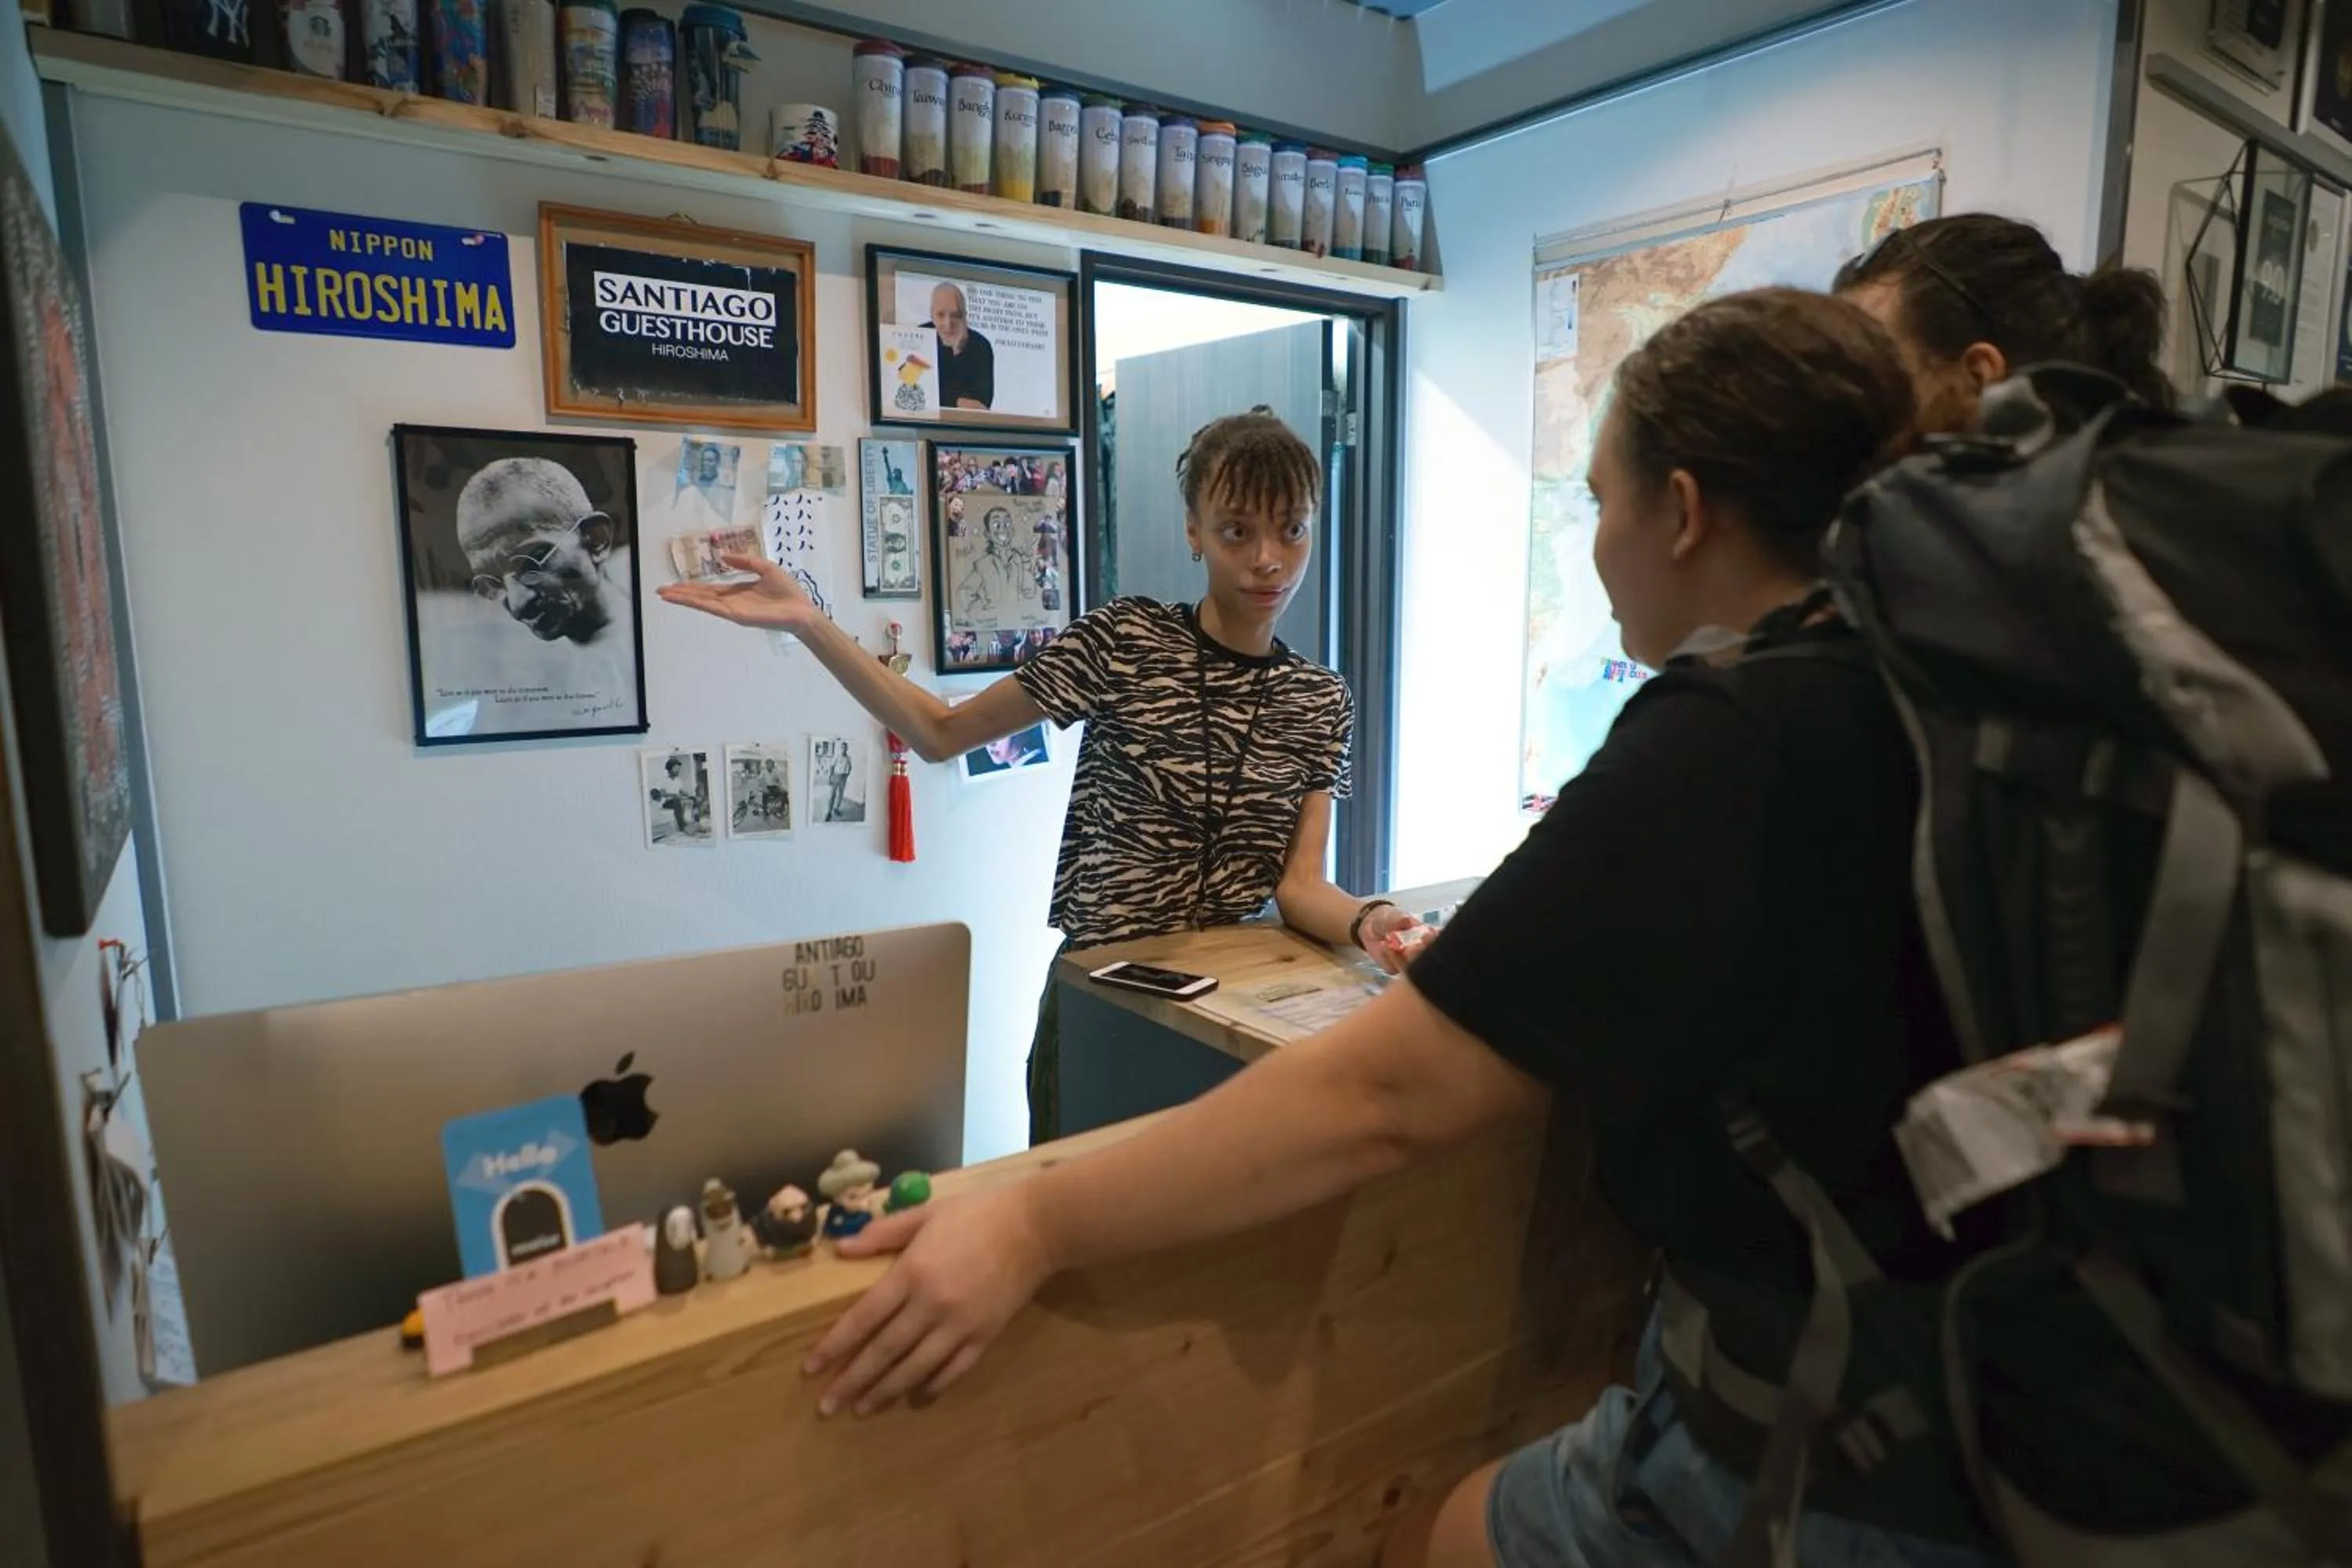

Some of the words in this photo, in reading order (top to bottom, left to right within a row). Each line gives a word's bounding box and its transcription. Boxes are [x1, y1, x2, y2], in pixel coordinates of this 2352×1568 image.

[329, 229, 434, 261] NIPPON
[255, 261, 507, 332] HIROSHIMA
[598, 278, 773, 321] SANTIAGO
[600, 310, 775, 348] GUESTHOUSE
[652, 343, 730, 361] HIROSHIMA
[866, 499, 877, 514] OF
[866, 517, 878, 563] STATUE
[481, 1143, 557, 1178] Hello
